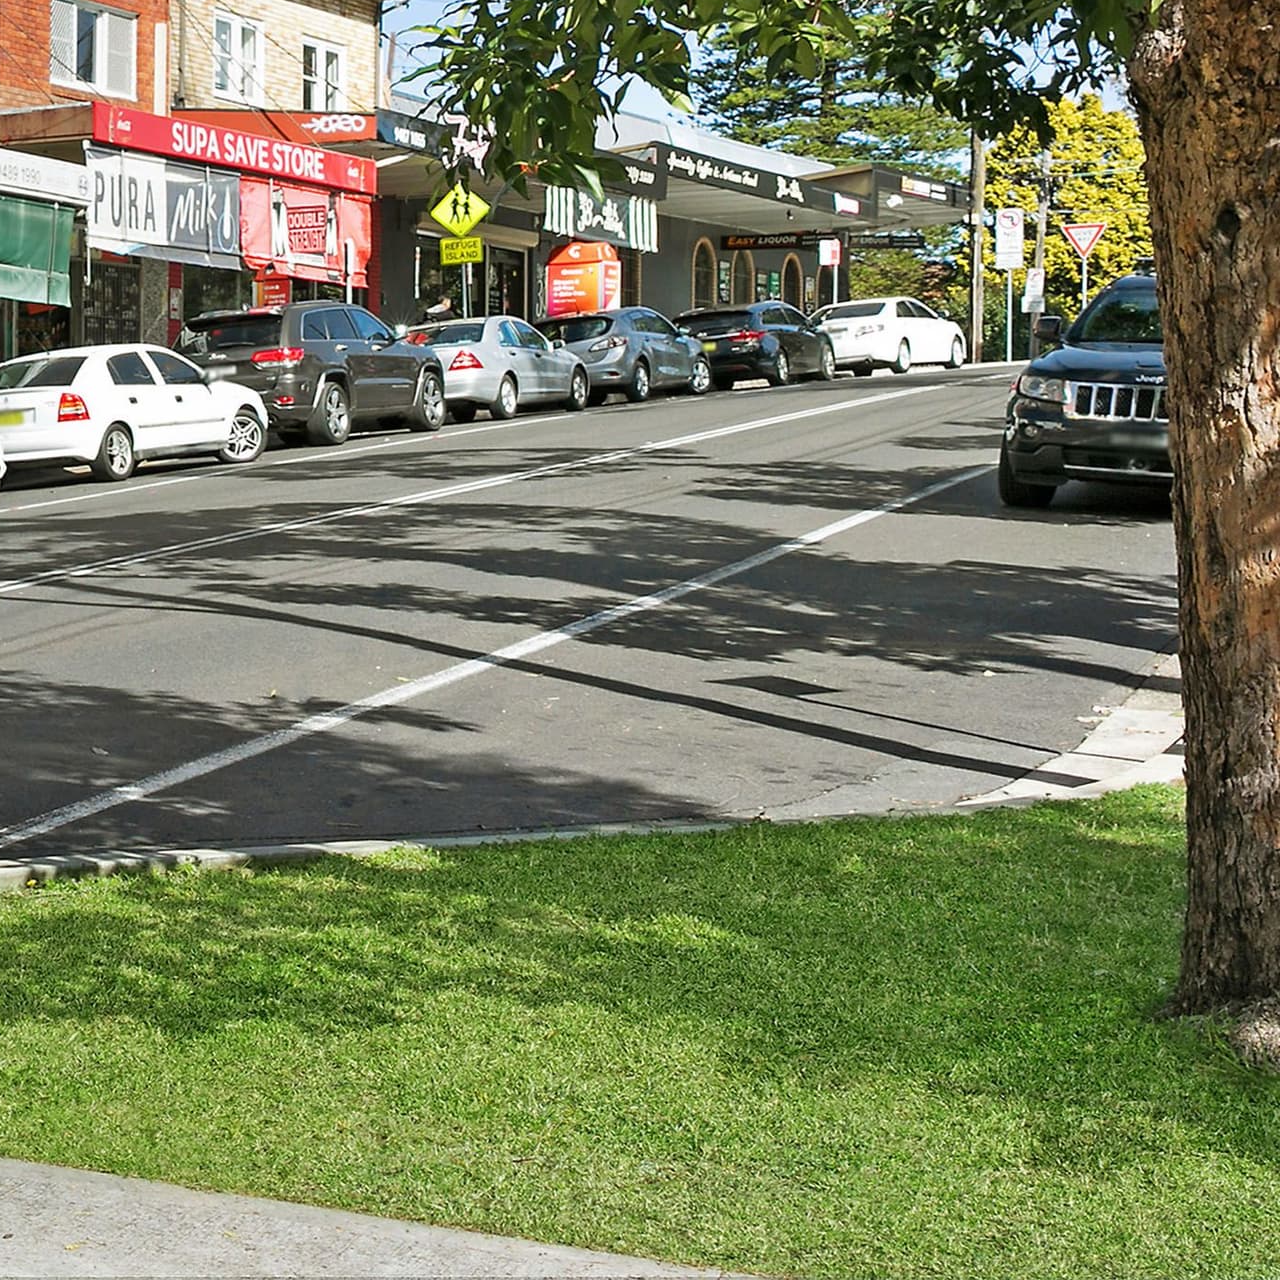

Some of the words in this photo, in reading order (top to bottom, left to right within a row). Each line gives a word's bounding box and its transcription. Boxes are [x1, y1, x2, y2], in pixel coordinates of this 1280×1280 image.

[172, 122, 220, 162] SUPA
[224, 133, 270, 170] SAVE
[272, 142, 325, 180] STORE
[95, 170, 156, 233] PURA
[170, 182, 218, 243] Milk
[288, 211, 325, 228] DOUBLE
[288, 228, 326, 251] STRENGTH
[444, 239, 479, 251] REFUGE
[758, 235, 797, 245] LIQUOR
[445, 250, 478, 261] ISLAND
[1135, 374, 1164, 385] Jeep
